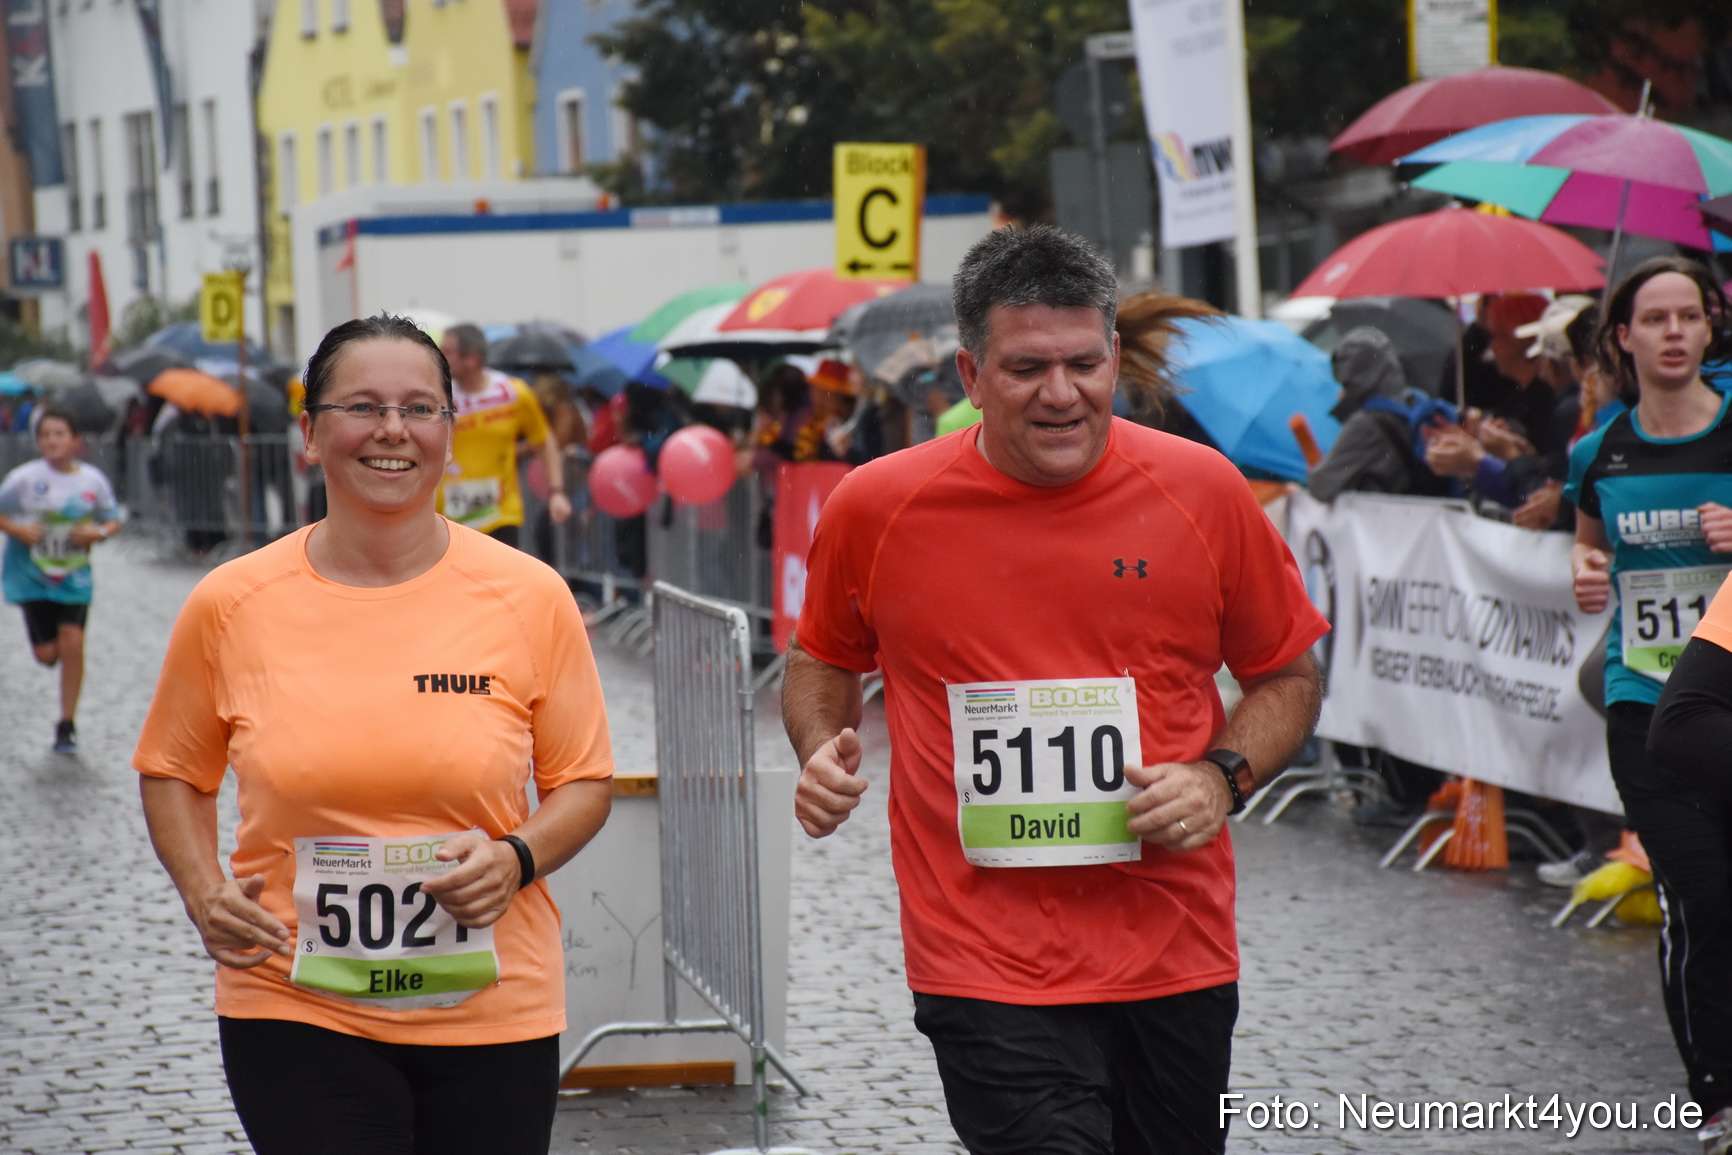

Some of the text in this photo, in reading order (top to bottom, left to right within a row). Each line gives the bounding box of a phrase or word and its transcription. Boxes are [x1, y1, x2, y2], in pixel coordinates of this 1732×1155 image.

[858, 186, 898, 250] C
[212, 291, 234, 328] D
[1617, 508, 1704, 535] HUBE
[1637, 595, 1707, 641] 511
[1658, 652, 1679, 669] Co
[413, 674, 491, 695] THULE
[964, 686, 1121, 715] NeuerMarkt BOCK
[1029, 709, 1058, 717] inspired
[1060, 709, 1069, 717] by
[1093, 708, 1123, 717] concepts
[972, 724, 1125, 796] 5110
[963, 790, 971, 804] S
[1010, 812, 1081, 840] David
[312, 857, 372, 869] NeuerMarkt
[384, 866, 413, 874] inspired
[415, 865, 425, 873] by
[425, 863, 446, 871] smart
[316, 881, 468, 950] 502
[305, 940, 314, 953] S
[369, 969, 424, 994] Elke
